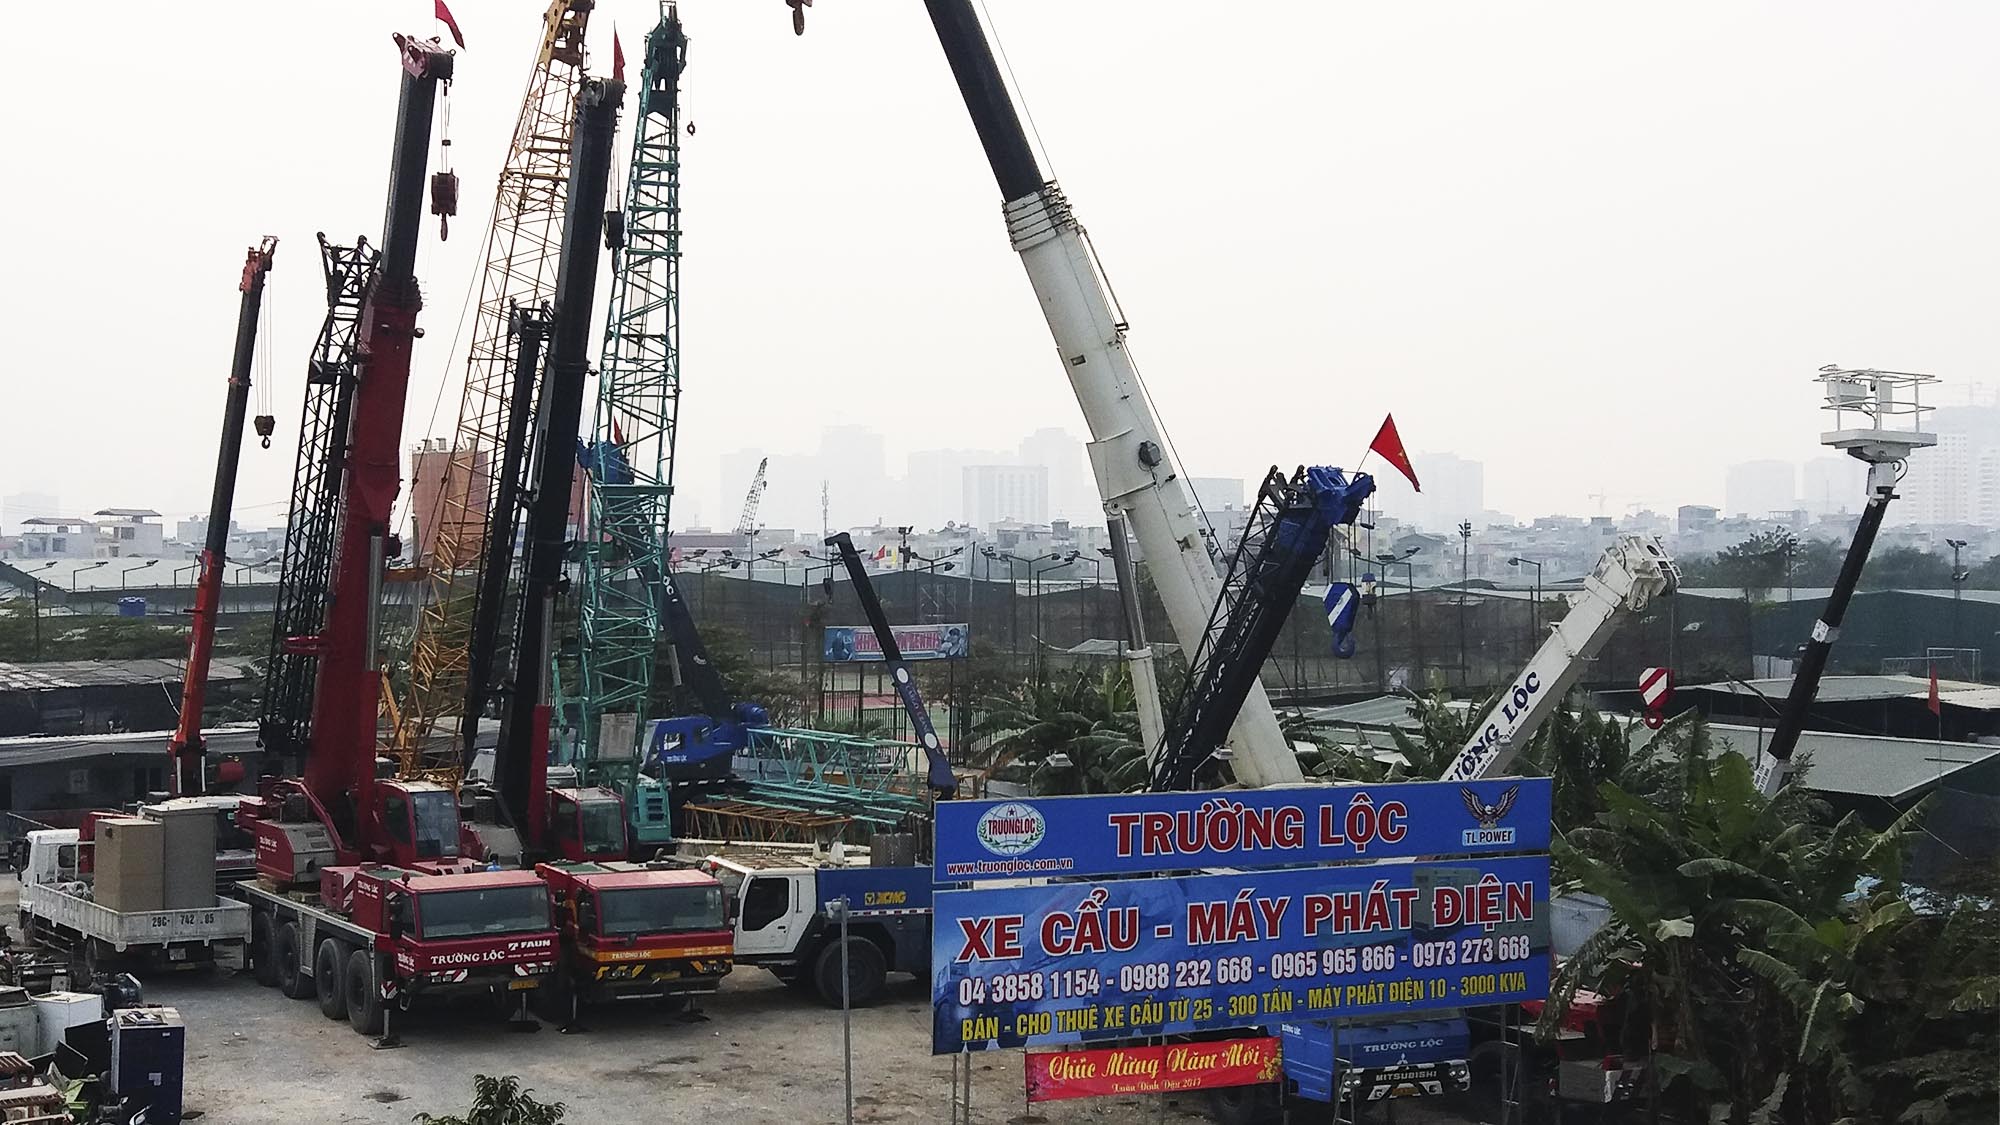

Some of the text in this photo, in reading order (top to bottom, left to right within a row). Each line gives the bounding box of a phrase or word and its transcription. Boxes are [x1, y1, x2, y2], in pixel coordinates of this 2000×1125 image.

[1502, 672, 1540, 724] LỘC
[988, 818, 1036, 835] TRUONGLOC
[1109, 792, 1408, 857] TRƯỜNG LỘC
[1465, 832, 1477, 843] TL
[947, 857, 1073, 875] www.truongloc.com.vn
[955, 873, 1534, 964] XE CẨU - MÁY PHÁT ĐIỆN
[521, 939, 551, 949] FAUN
[430, 950, 480, 965] TRƯỜNG
[482, 949, 505, 963] LỘC
[959, 978, 985, 1006] 04
[991, 973, 1043, 1003] 3858
[1050, 968, 1100, 998] 1154
[1120, 962, 1169, 992] 0988
[1175, 959, 1211, 988] 232
[1217, 956, 1252, 984] 668
[1271, 951, 1317, 980] 0965
[1323, 947, 1356, 975] 965
[1362, 945, 1395, 971] 866
[1413, 941, 1457, 968] 0973
[1461, 938, 1493, 964] 273
[1498, 935, 1530, 960] 668
[962, 1013, 998, 1041] BÁN
[1017, 1014, 1051, 1036] CHO
[1056, 1004, 1098, 1032] THUÊ
[1104, 1006, 1125, 1028] XE
[1168, 996, 1190, 1022] TỪ
[1193, 999, 1213, 1021] 25
[1228, 994, 1258, 1017] 300
[1262, 985, 1293, 1013] TẤN
[1308, 984, 1342, 1009] MÁY
[1346, 980, 1385, 1006] PHÁT
[1389, 977, 1424, 1006] ĐIỆN
[1429, 978, 1446, 998] 10
[1461, 975, 1495, 996] 3000
[1500, 972, 1526, 993] KVA
[1420, 1038, 1444, 1049] LỘC
[1048, 1043, 1260, 1080] Chúc Mừng Năm Mới
[1376, 1071, 1437, 1082] MITSUBISHI
